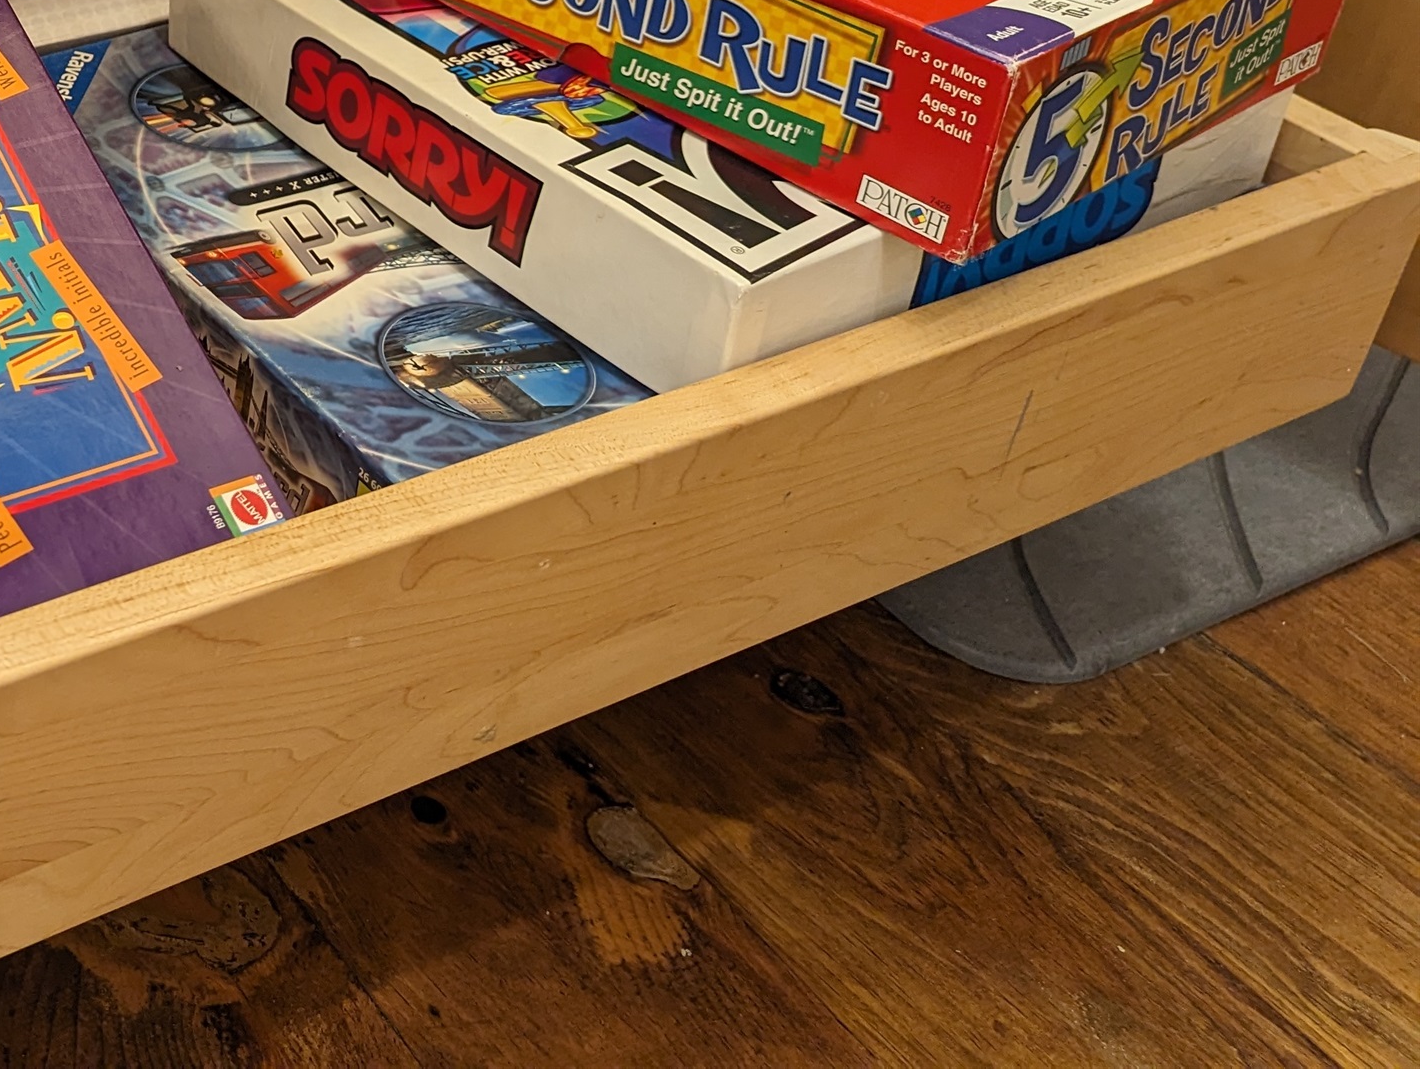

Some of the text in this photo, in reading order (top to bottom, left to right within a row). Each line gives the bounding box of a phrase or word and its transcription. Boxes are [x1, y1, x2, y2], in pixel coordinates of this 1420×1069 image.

[986, 25, 1025, 43] Adult
[1230, 18, 1287, 68] Just Spit
[449, 59, 501, 80] ICE
[478, 67, 528, 84] WITH
[894, 39, 987, 89] For 3 or More
[1233, 64, 1247, 85] it
[1279, 44, 1322, 82] PATCH
[620, 57, 671, 93] Just
[673, 77, 722, 113] Spit
[724, 97, 744, 122] it
[929, 73, 982, 107] Players
[917, 110, 973, 144] to Adult
[920, 92, 977, 127] Ages 10
[1103, 64, 1220, 183] RULE
[288, 40, 540, 263] SORRY!
[1014, 88, 1094, 226] 5
[860, 178, 946, 241] PATCH
[236, 489, 267, 525] MATTEL
[254, 473, 284, 520] GAMES
[206, 504, 226, 530] B9176
